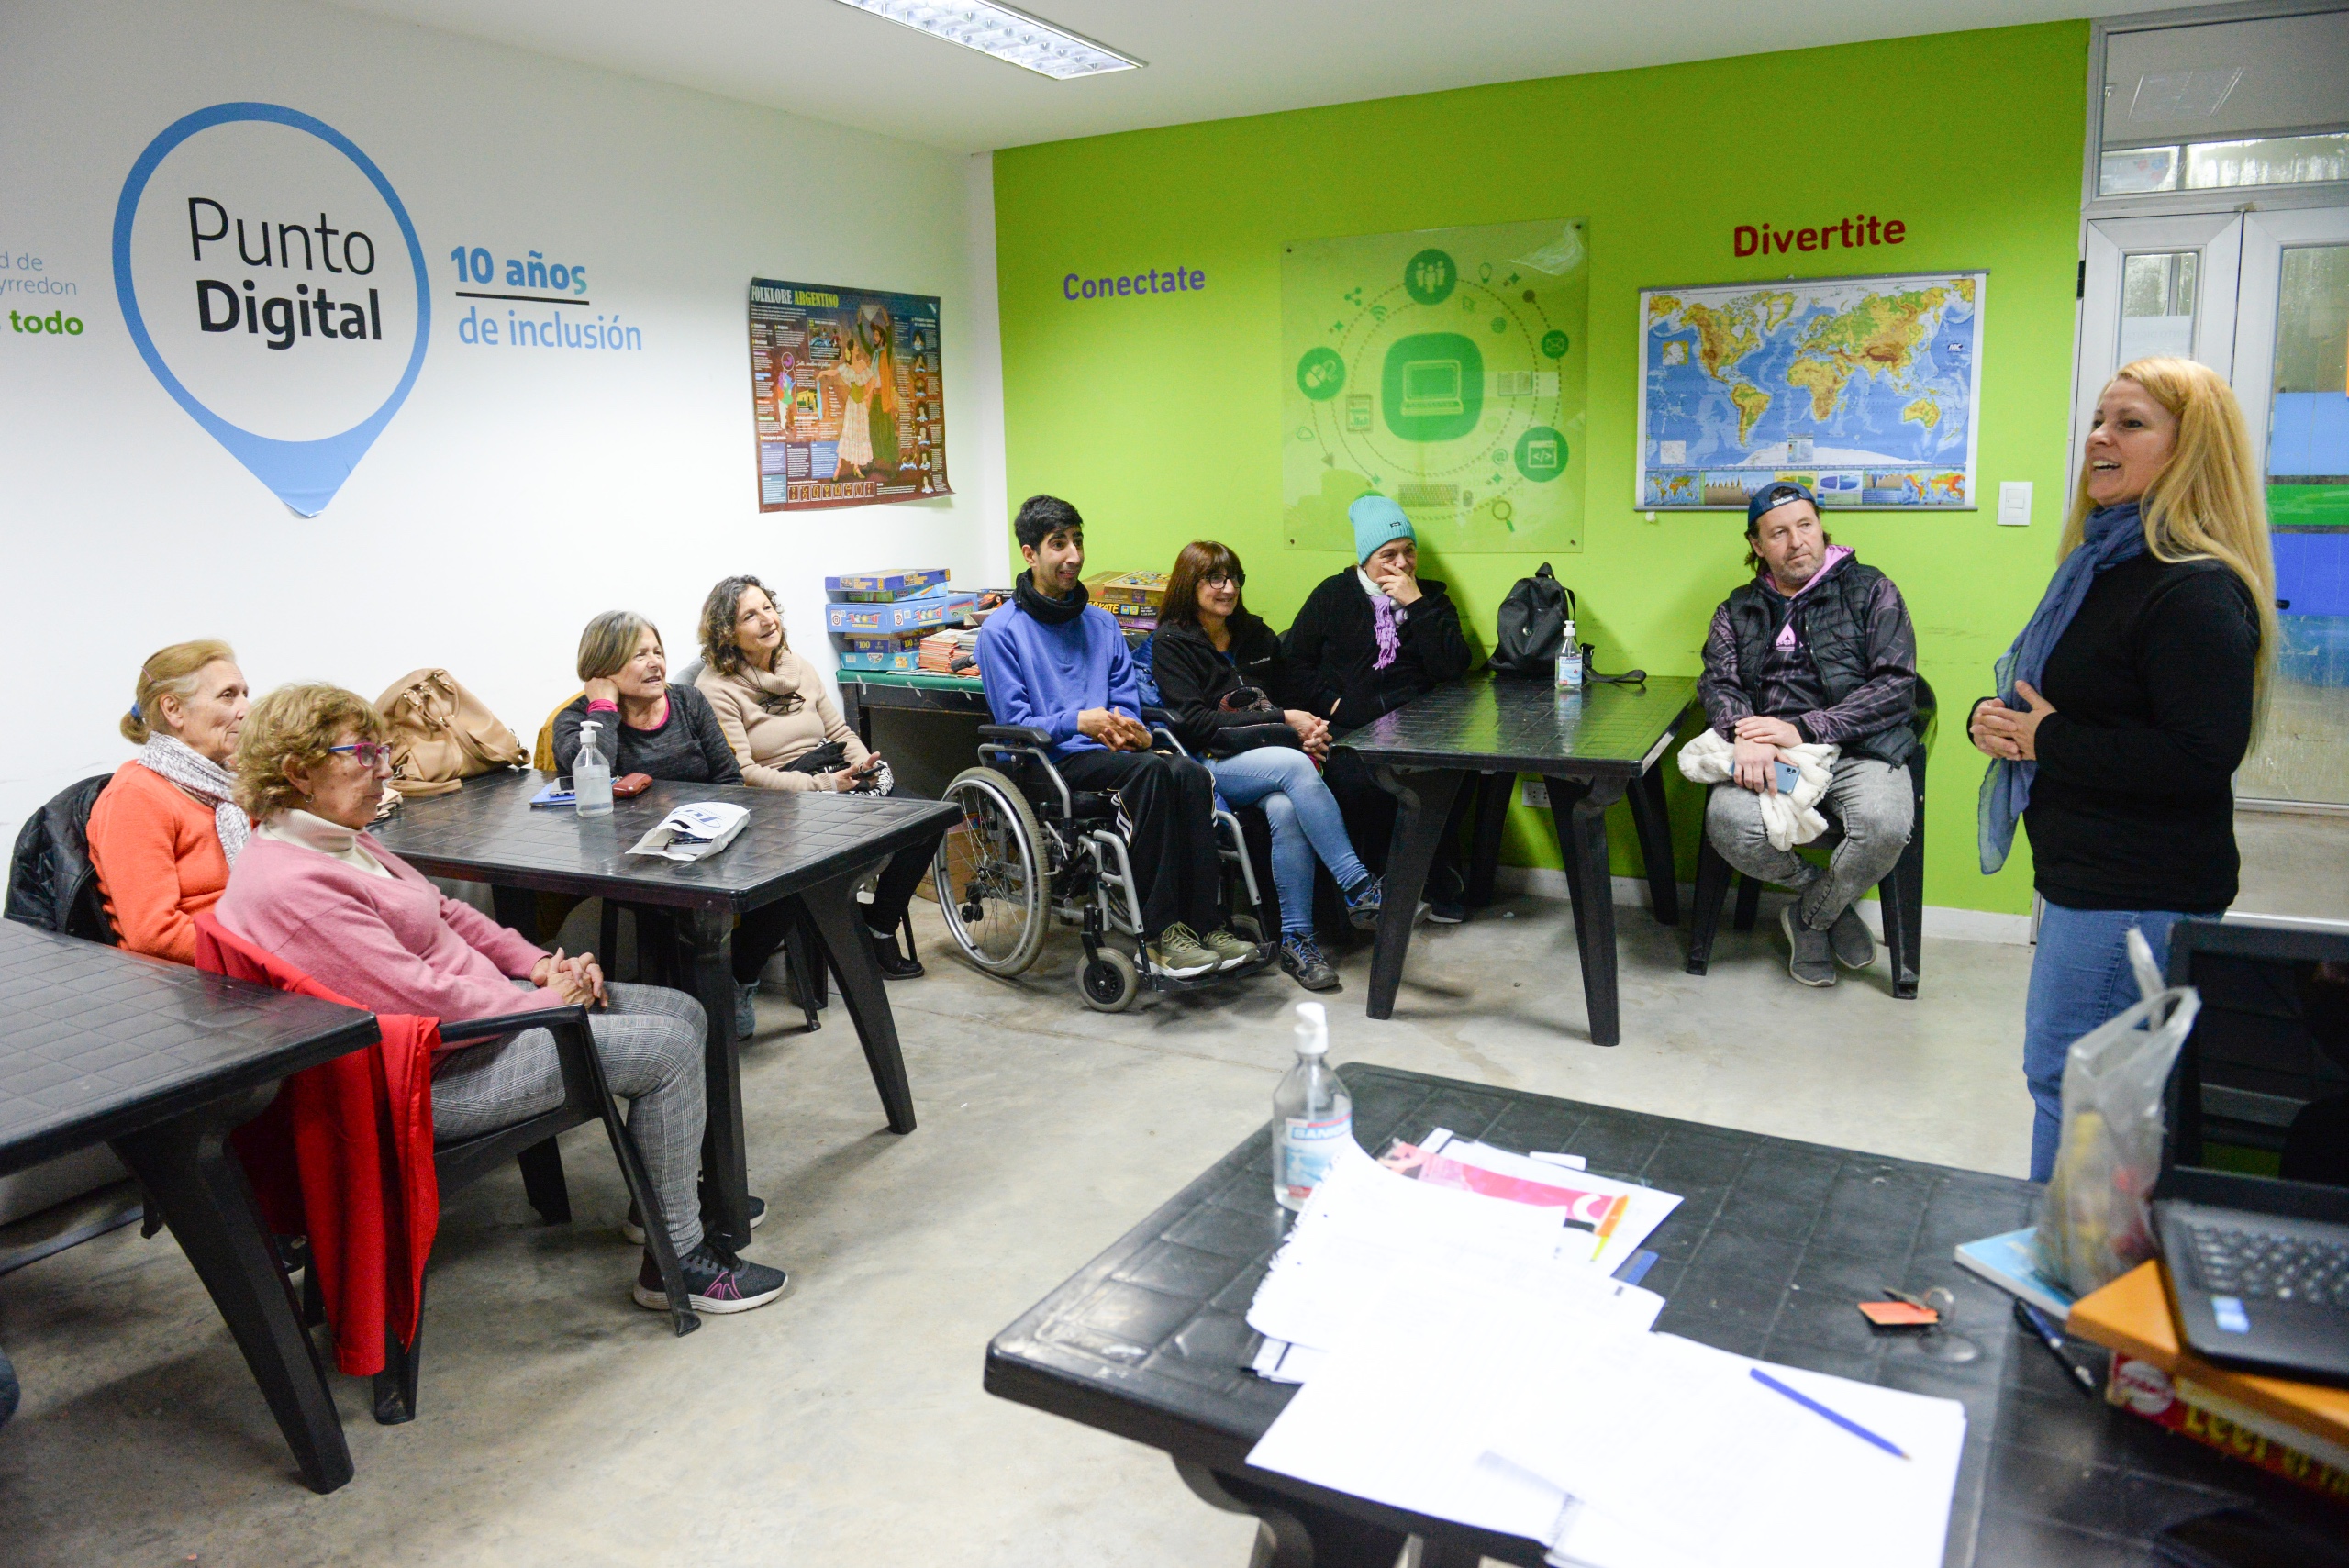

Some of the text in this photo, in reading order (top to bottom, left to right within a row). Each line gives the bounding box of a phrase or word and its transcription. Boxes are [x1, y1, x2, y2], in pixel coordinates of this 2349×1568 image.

[187, 196, 377, 276] Punto
[1733, 214, 1907, 257] Divertite
[17, 252, 44, 272] de
[451, 245, 588, 295] 10 años
[751, 285, 839, 309] FOLKLORE ARGENTINO
[1063, 265, 1206, 301] Conectate
[9, 309, 84, 336] todo
[195, 278, 384, 350] Digital
[458, 306, 643, 352] de inclusión
[1772, 495, 1794, 506] Wilson
[859, 640, 871, 649] 100
